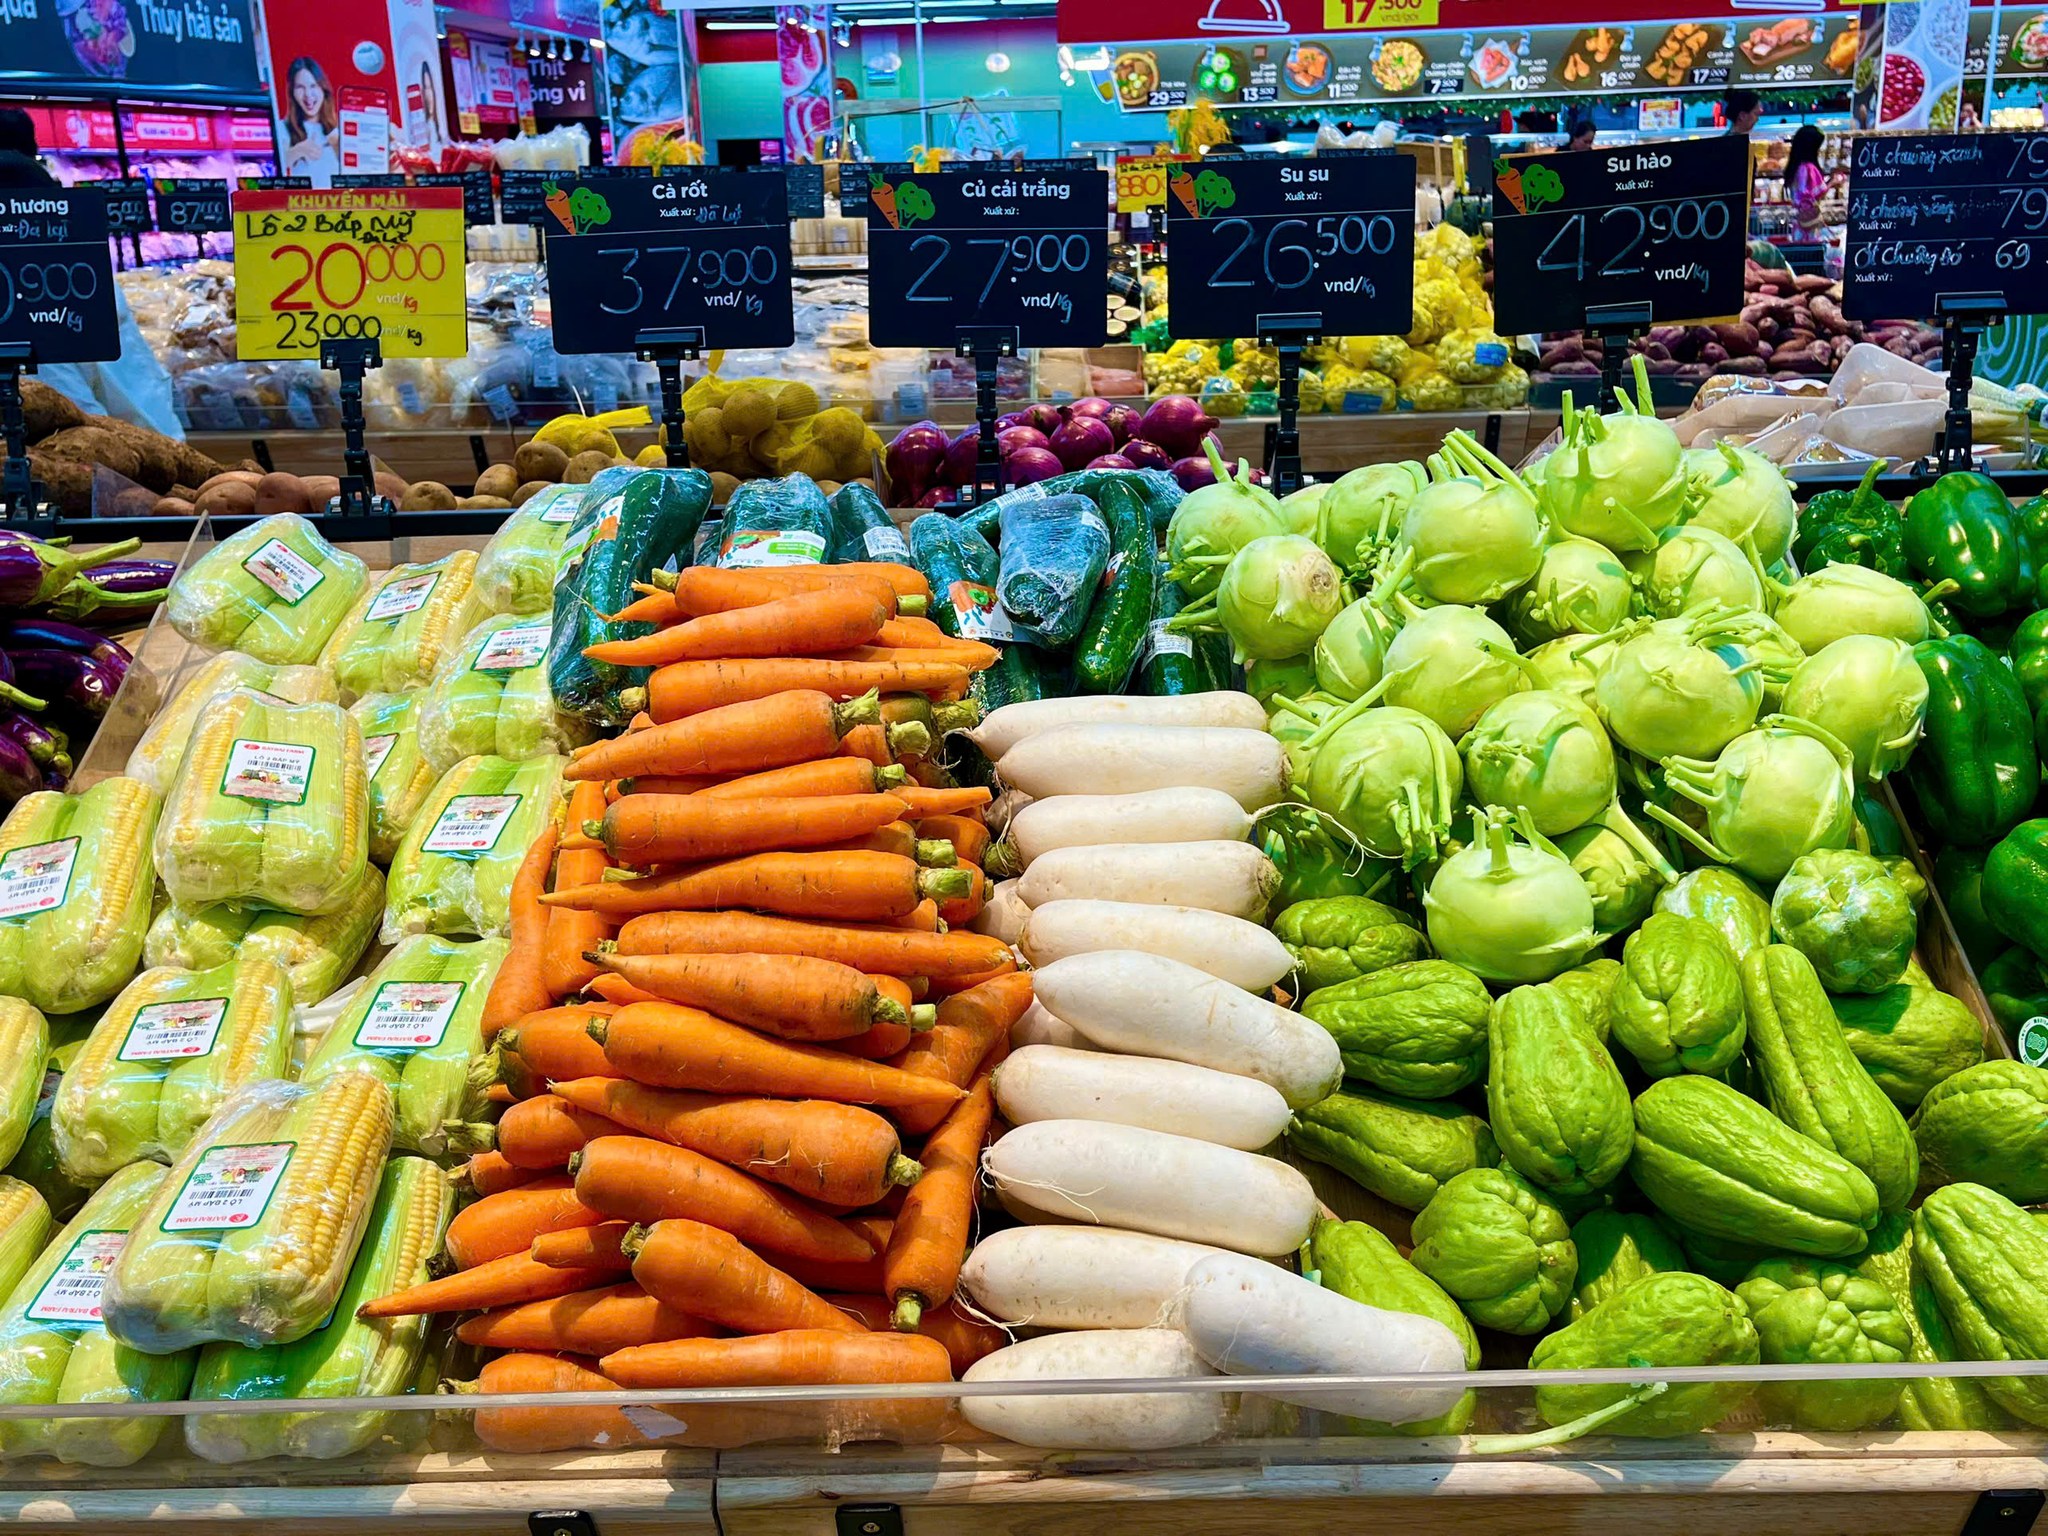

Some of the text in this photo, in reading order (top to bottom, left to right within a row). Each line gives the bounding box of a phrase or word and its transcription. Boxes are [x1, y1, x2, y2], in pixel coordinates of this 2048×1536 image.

[528, 59, 567, 80] Thịt
[529, 84, 564, 105] óng
[1606, 151, 1673, 173] Su hào
[1280, 167, 1330, 183] Su su
[1861, 168, 1883, 178] Xuất
[651, 179, 709, 200] Cà rốt
[961, 177, 1071, 200] Củ cải trắng
[1615, 180, 1637, 192] Xuất
[287, 189, 366, 208] KHUYẾN
[1284, 190, 1305, 202] Xuất
[10, 198, 69, 215] hương
[659, 207, 680, 218] Xuất
[983, 205, 1004, 216] Xuất
[1858, 221, 1880, 231] Xuất
[1855, 273, 1877, 283] Xuất
